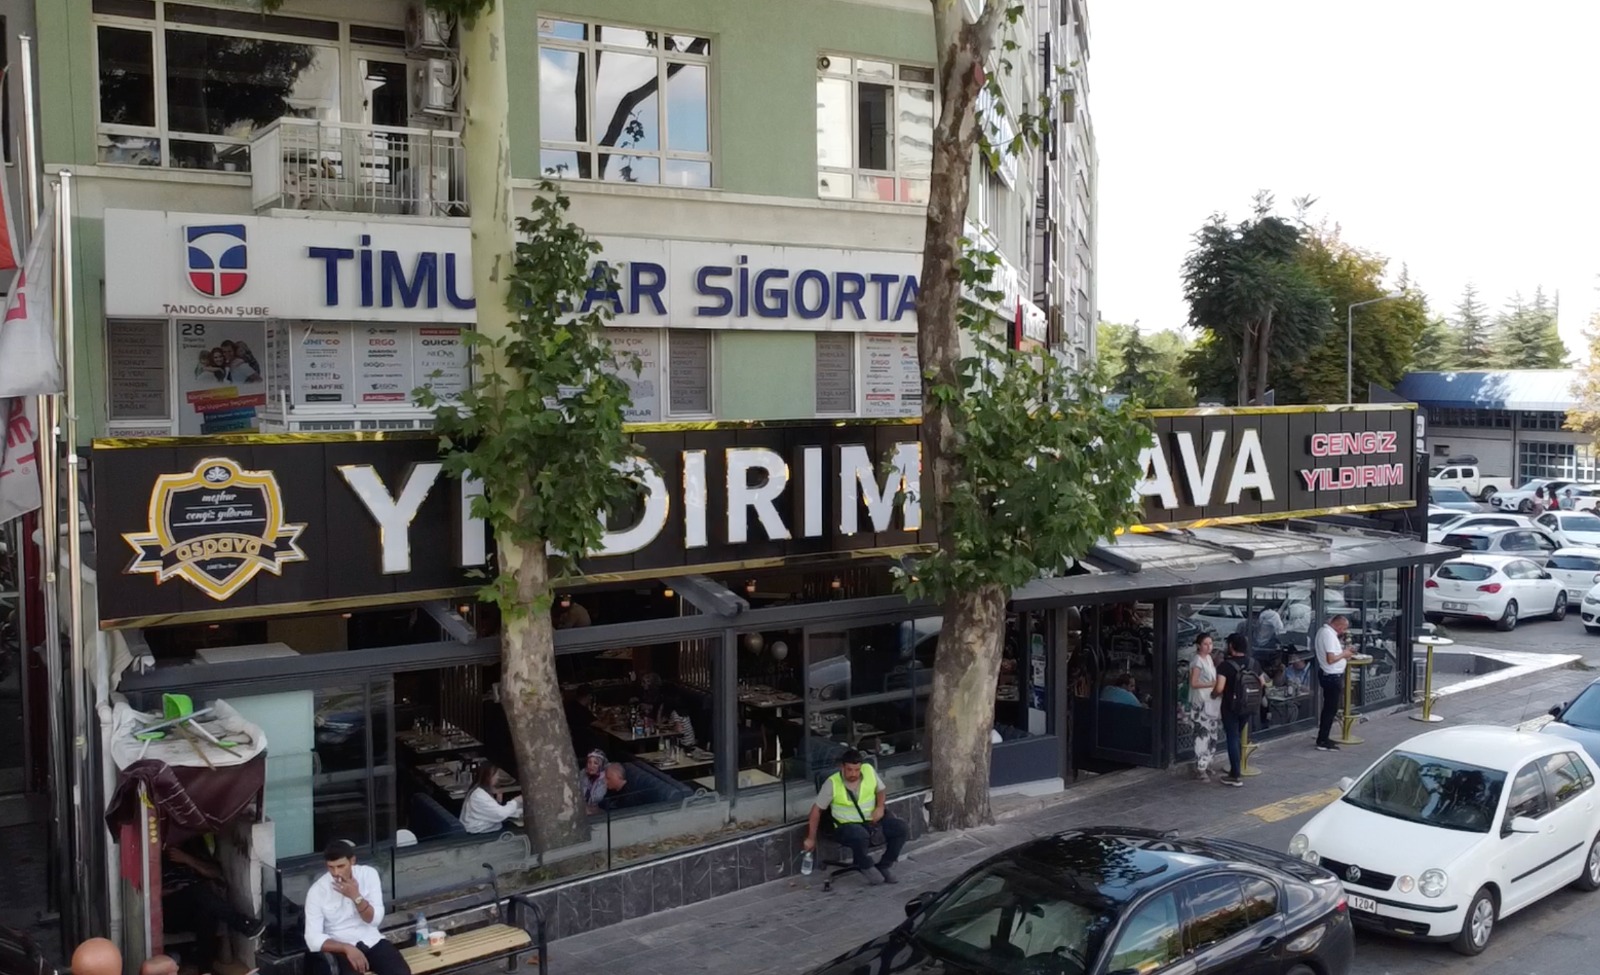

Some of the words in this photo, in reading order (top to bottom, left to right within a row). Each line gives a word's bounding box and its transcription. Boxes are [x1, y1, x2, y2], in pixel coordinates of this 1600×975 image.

[697, 254, 919, 321] SİGORTA
[162, 303, 235, 316] TANDOĞAN
[236, 305, 270, 318] ŞUBE
[181, 323, 206, 336] 28
[369, 338, 396, 346] ERGO
[1301, 462, 1405, 493] YILDIRIM
[201, 490, 238, 505] meşhur
[339, 445, 921, 575] YIDIRIM
[176, 538, 262, 560] aspava
[1355, 897, 1375, 911] 1204
